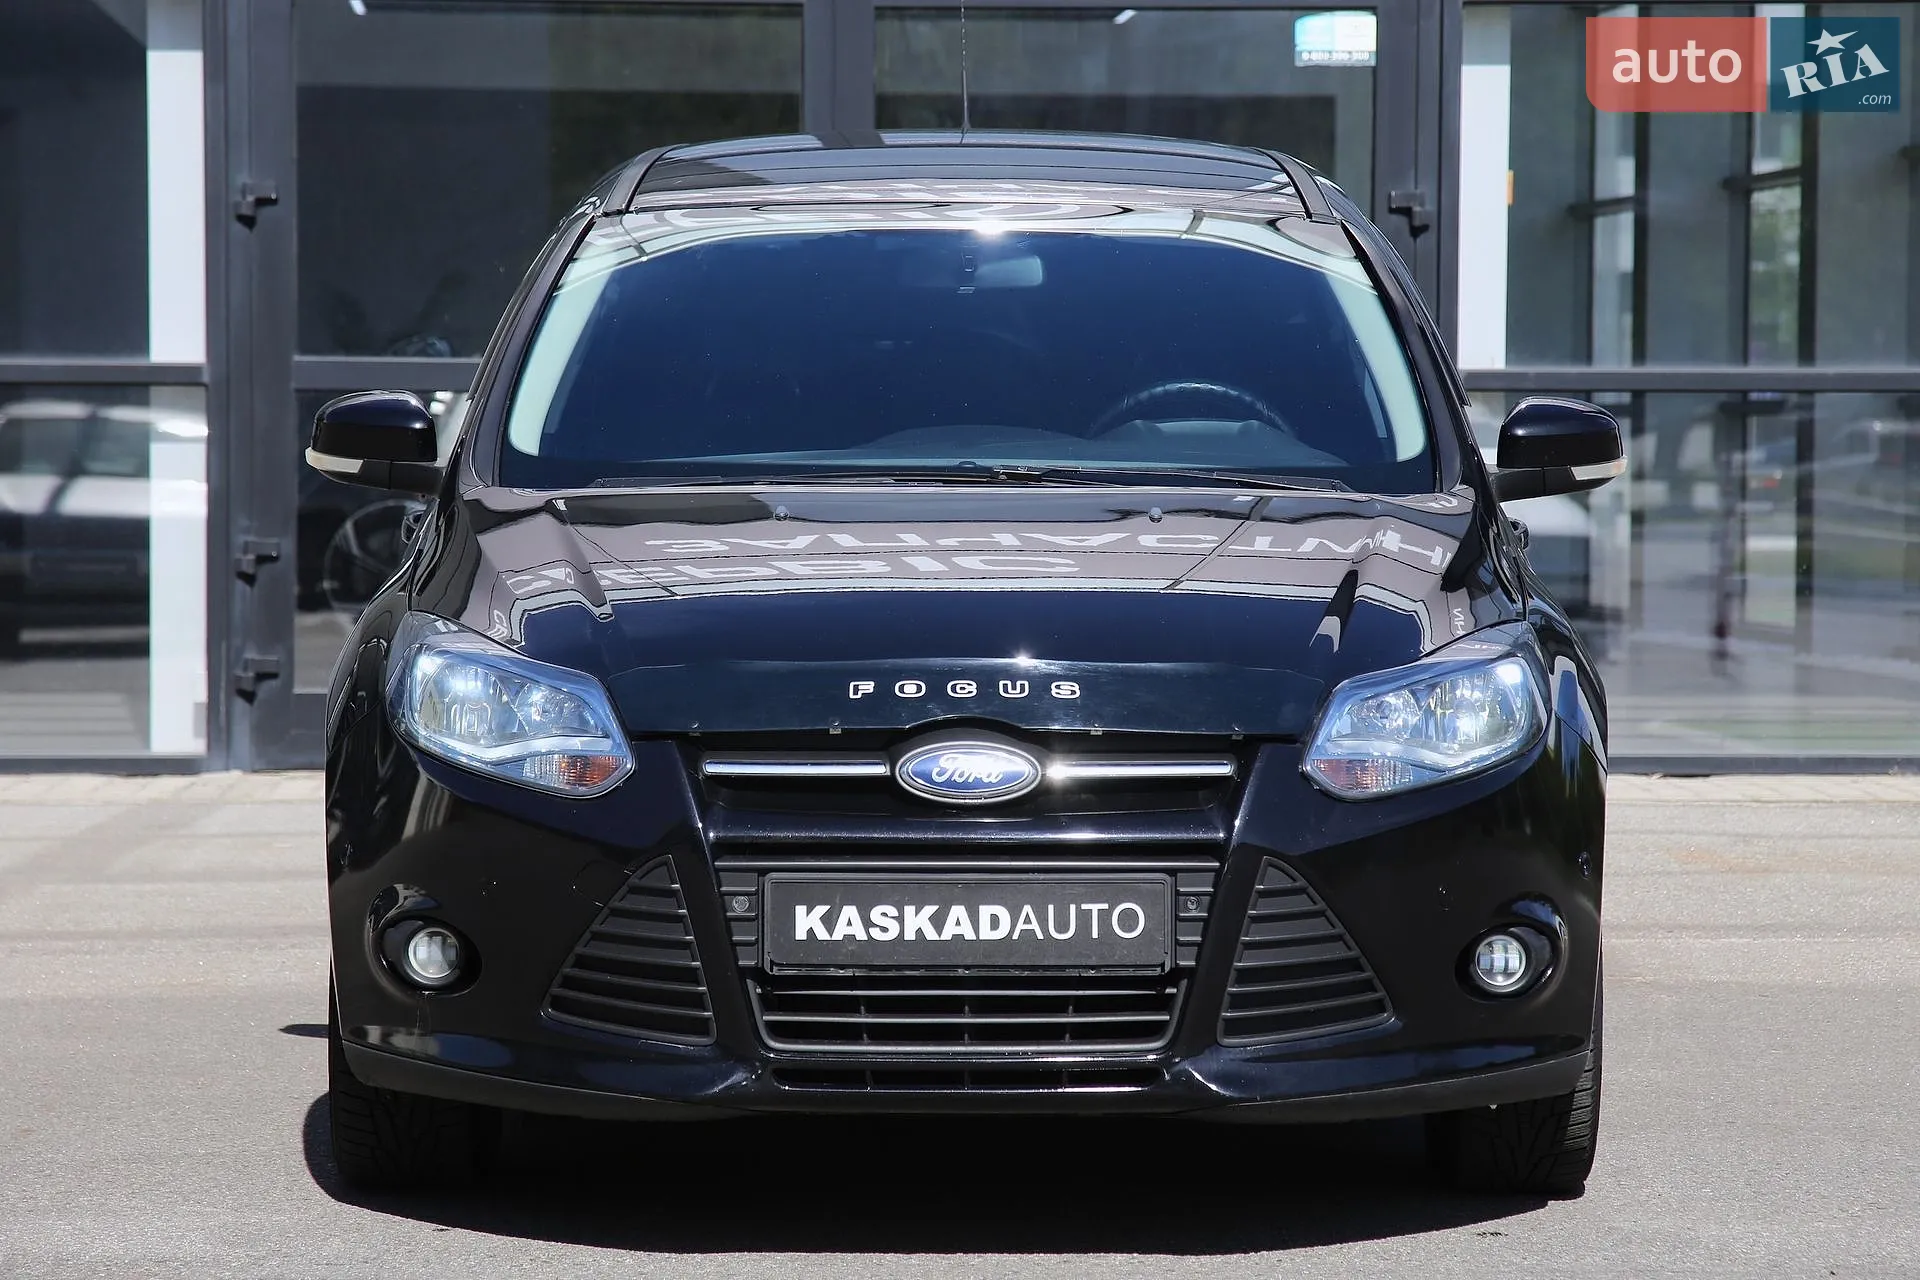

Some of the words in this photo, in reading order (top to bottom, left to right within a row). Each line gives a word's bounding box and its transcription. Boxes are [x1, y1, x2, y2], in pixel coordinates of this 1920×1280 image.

[849, 680, 1081, 699] FOCUS
[931, 754, 1004, 784] Ford
[795, 902, 1146, 942] KASKADAUTO
